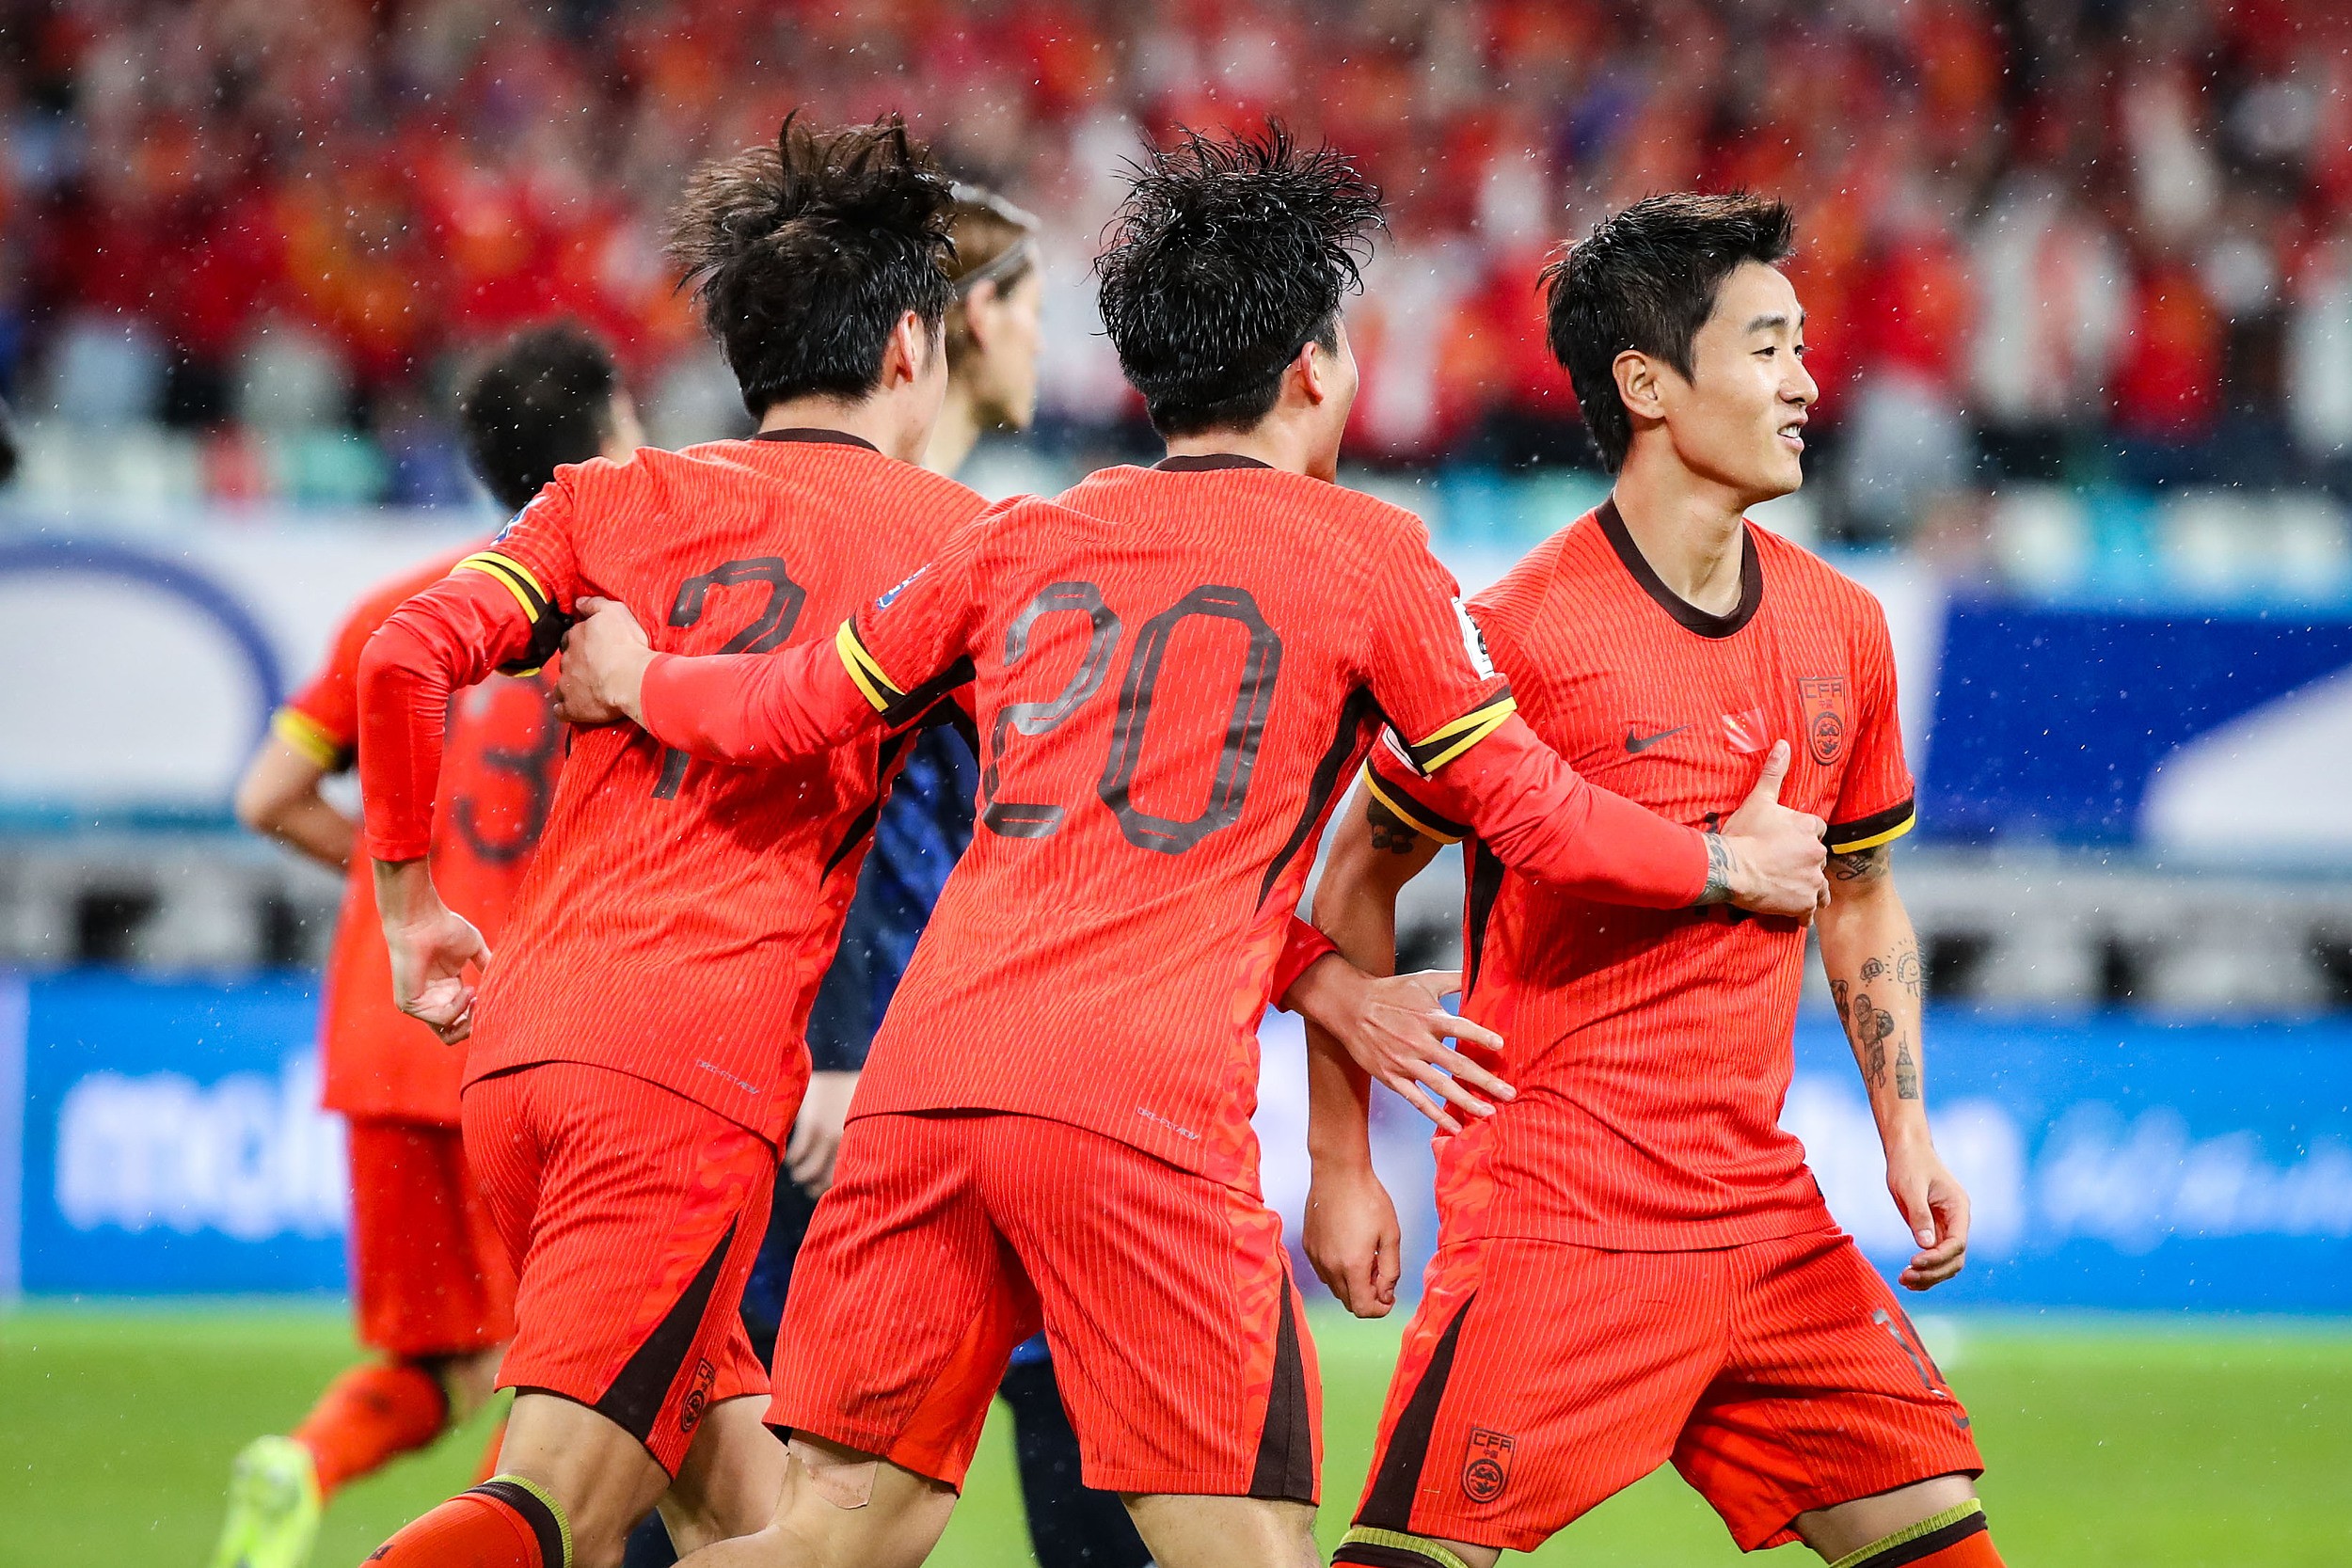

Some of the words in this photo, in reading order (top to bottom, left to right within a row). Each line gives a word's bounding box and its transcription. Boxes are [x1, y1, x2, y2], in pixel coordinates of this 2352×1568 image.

[982, 581, 1282, 855] 20
[1804, 682, 1843, 698] CFA
[443, 673, 562, 866] 3
[1473, 1432, 1512, 1453] CFA
